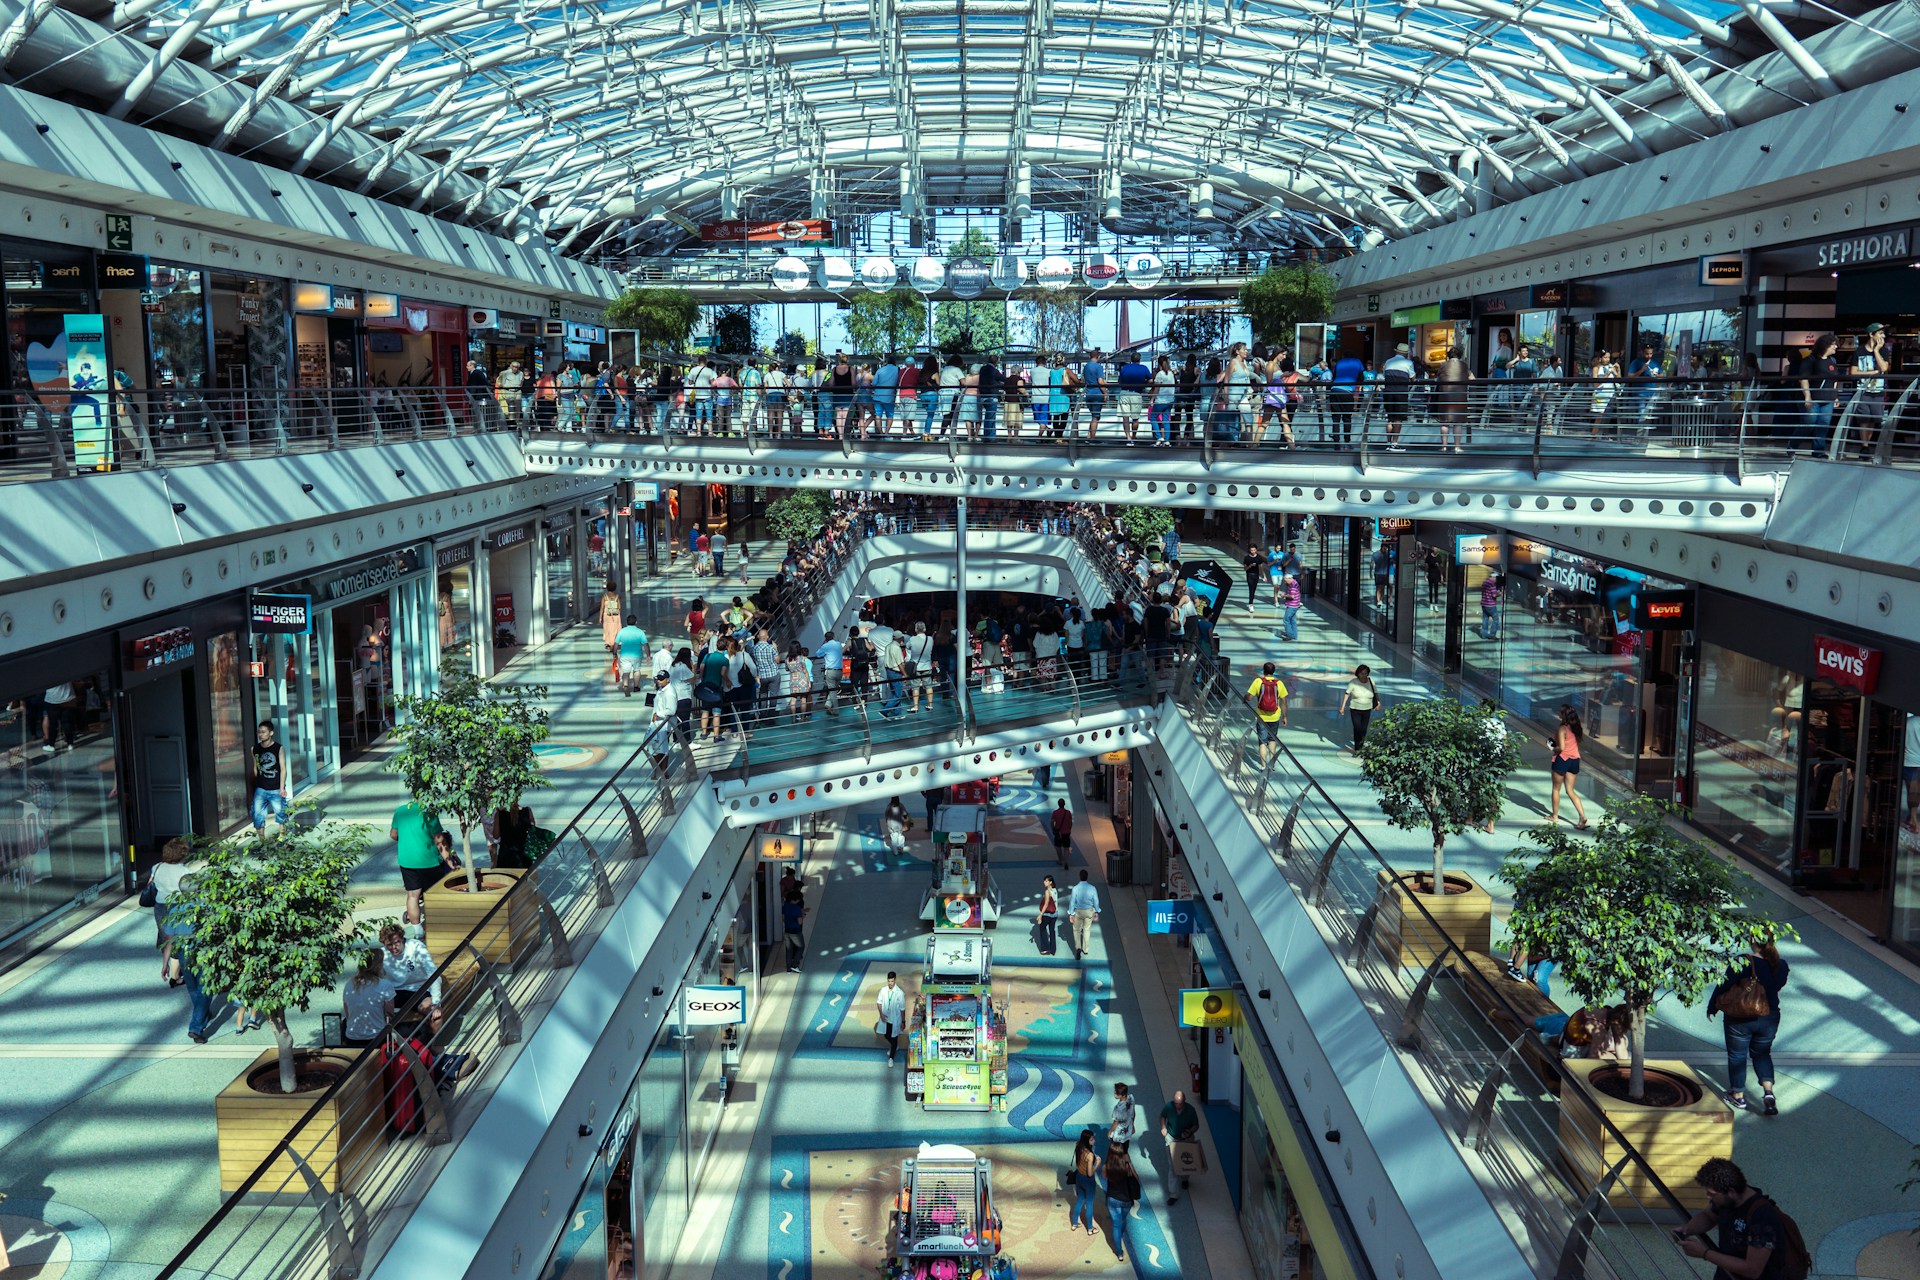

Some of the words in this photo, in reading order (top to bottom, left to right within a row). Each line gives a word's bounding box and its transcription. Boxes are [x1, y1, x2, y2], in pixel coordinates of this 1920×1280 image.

[1818, 232, 1907, 267] SEPHORA
[106, 266, 135, 276] fnac
[1711, 266, 1740, 274] SEPHORA
[241, 296, 260, 309] Funky
[240, 310, 260, 322] Project
[497, 527, 525, 547] CORTEFIEL
[437, 544, 471, 566] CORTEFIEL
[1461, 545, 1499, 553] Samsonite
[1540, 559, 1597, 595] Samsonite
[253, 605, 305, 616] HILFIGER
[272, 616, 306, 624] DENIM
[1155, 912, 1189, 924] MEO
[688, 1000, 742, 1012] GEOX
[941, 1083, 982, 1091] Science4you
[917, 1242, 964, 1251] smartlunch
